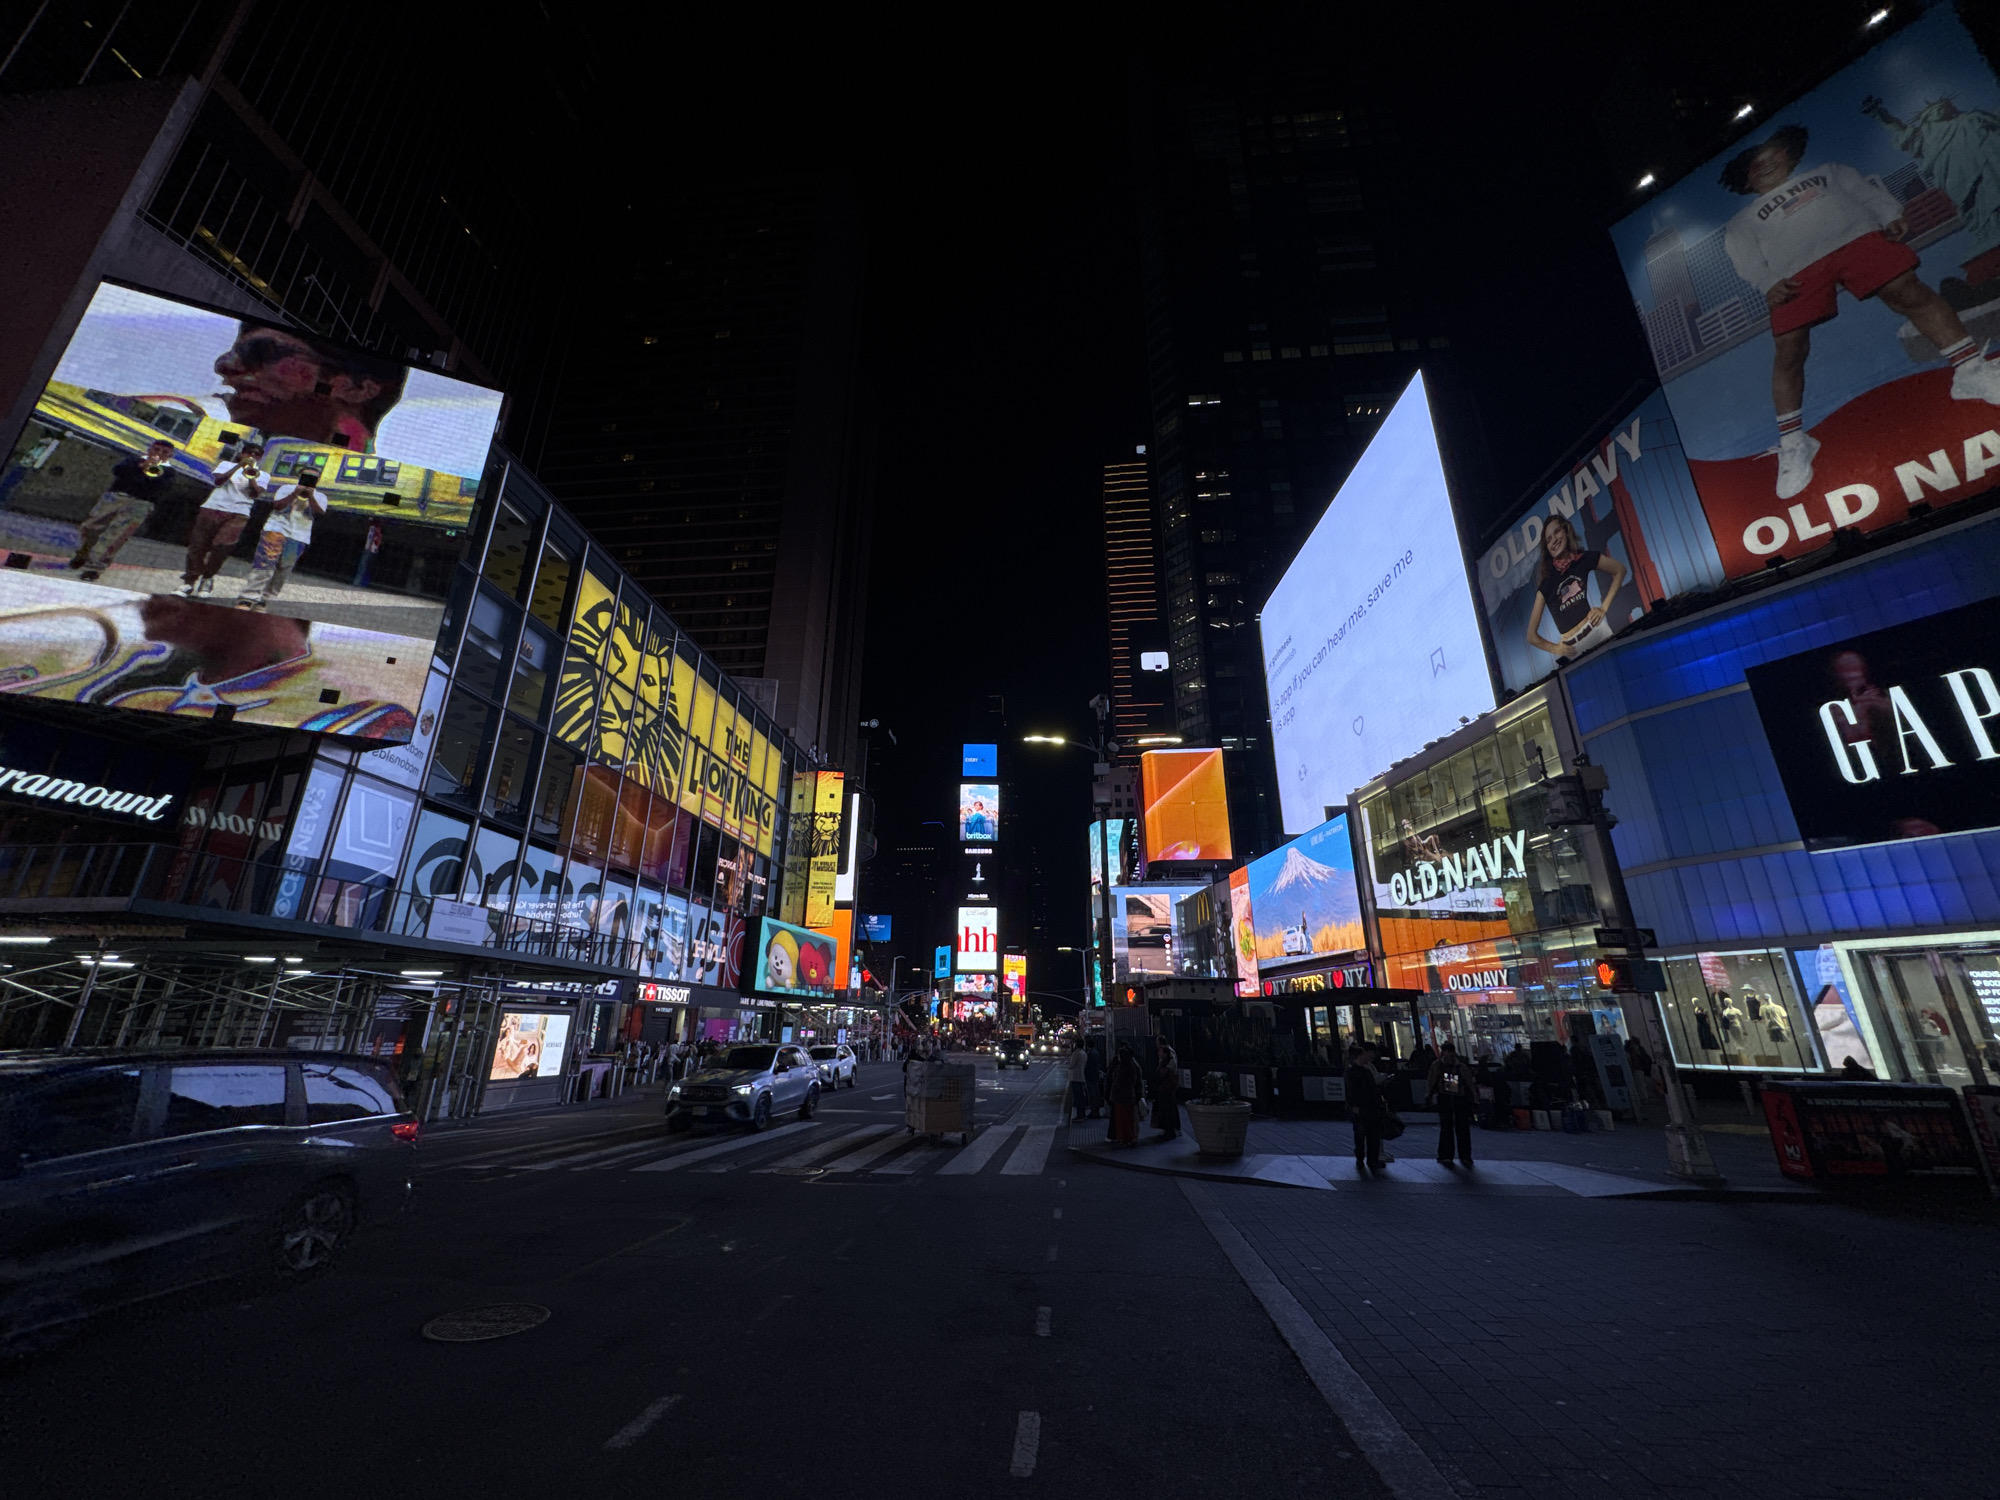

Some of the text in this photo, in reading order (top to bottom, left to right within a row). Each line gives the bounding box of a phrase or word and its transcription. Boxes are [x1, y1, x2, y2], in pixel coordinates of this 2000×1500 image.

[1757, 175, 1827, 221] OLD NAVY
[1490, 416, 1642, 578] OLD NAVY
[1742, 482, 1880, 555] OLD
[1297, 662, 1312, 690] you
[1312, 646, 1328, 669] can
[1327, 622, 1348, 653] hear
[1367, 573, 1392, 608] save
[1393, 549, 1413, 580] me
[726, 726, 751, 766] THE
[1818, 666, 2000, 784] GAP
[0, 766, 174, 821] ramount
[689, 734, 771, 830] LION KING
[294, 785, 328, 852] NEWS
[1390, 829, 1526, 906] OLD NAVY
[1604, 933, 1625, 942] ONE
[656, 988, 689, 1002] TISSOT
[1448, 969, 1508, 990] OLD NAVY
